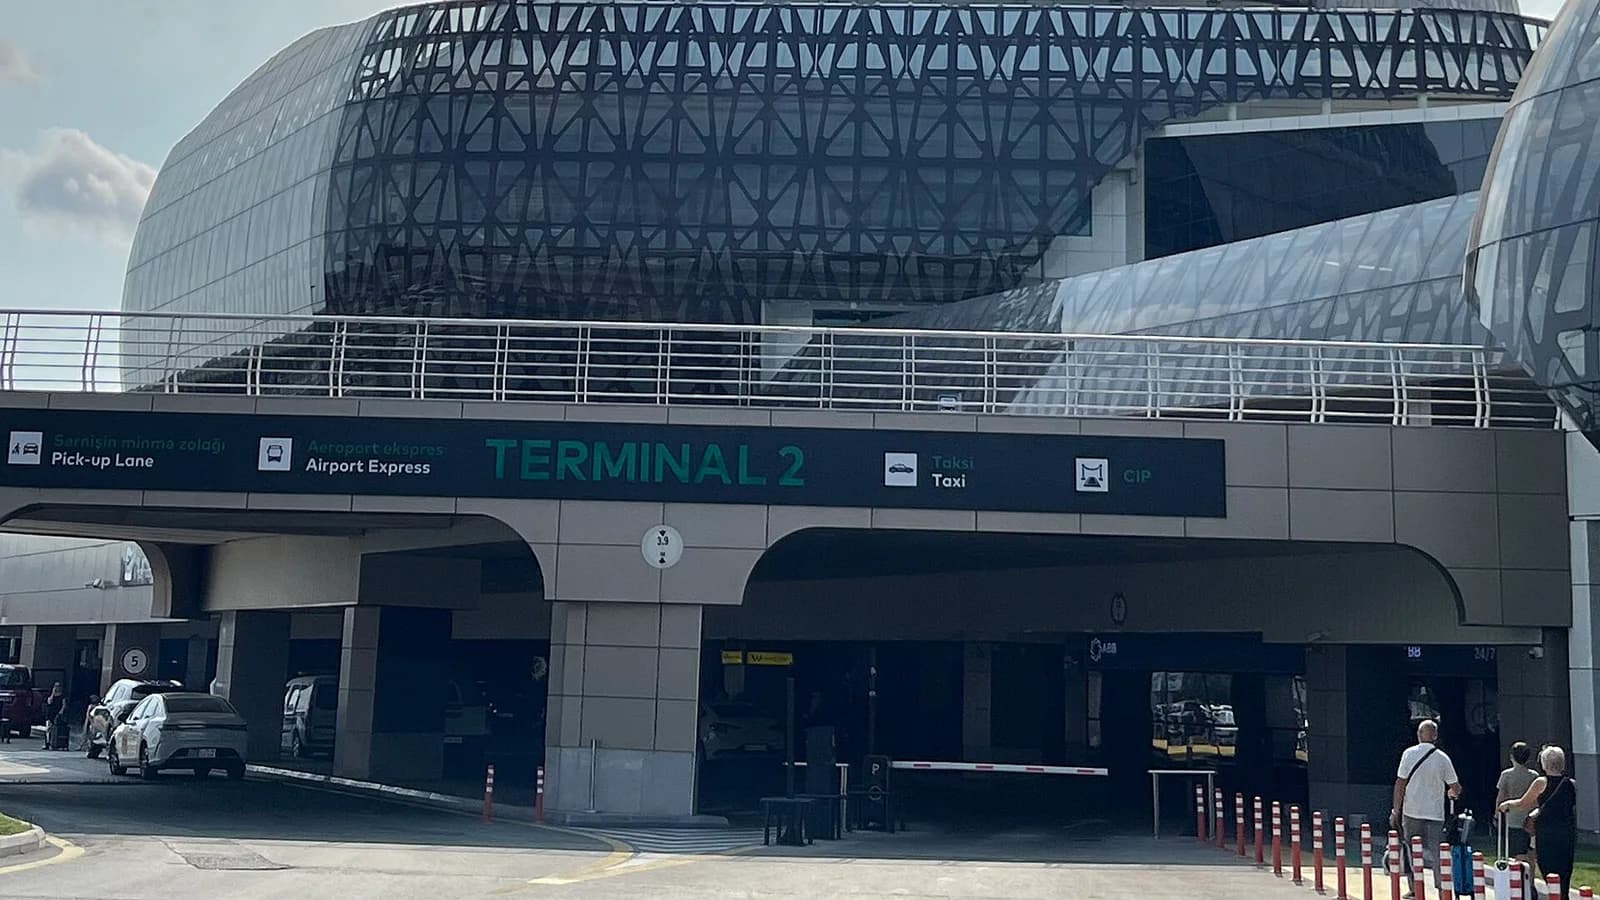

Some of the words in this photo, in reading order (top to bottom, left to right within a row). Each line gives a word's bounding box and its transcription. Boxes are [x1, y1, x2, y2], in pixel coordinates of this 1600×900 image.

[51, 451, 111, 470] Pick-up
[115, 453, 154, 468] Lane
[305, 457, 364, 475] Airport
[368, 459, 431, 477] Express
[485, 438, 767, 486] TERMINAL
[778, 444, 806, 487] 2
[931, 455, 974, 470] Taksi
[932, 473, 966, 488] Taxi
[1123, 469, 1151, 484] CIP
[657, 536, 669, 546] 3.9
[131, 656, 138, 667] 5
[1474, 647, 1496, 661] 24/7
[872, 763, 880, 775] P
